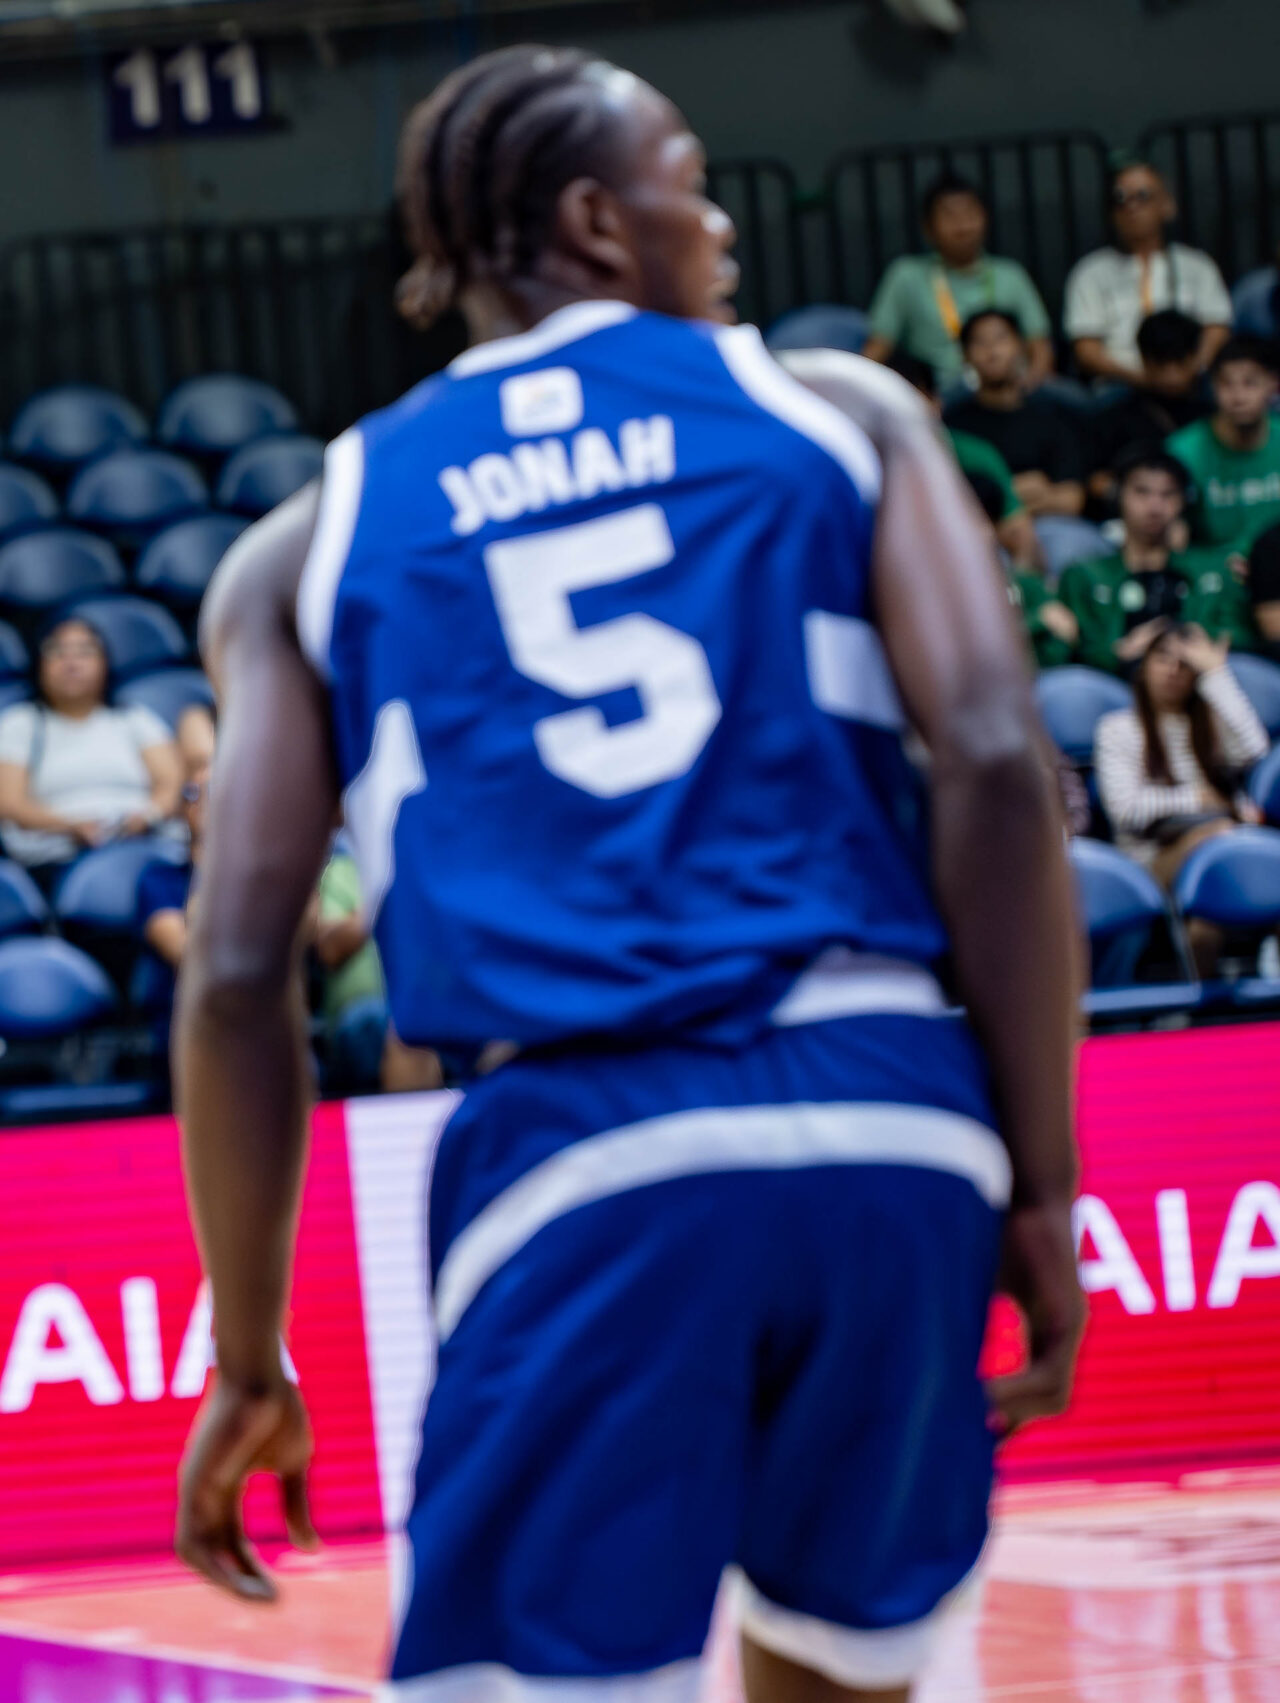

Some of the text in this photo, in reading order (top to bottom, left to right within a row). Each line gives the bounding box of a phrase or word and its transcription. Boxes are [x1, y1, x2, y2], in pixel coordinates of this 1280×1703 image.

[114, 45, 261, 127] 111
[438, 414, 676, 536] JONAH
[483, 502, 722, 799] 5
